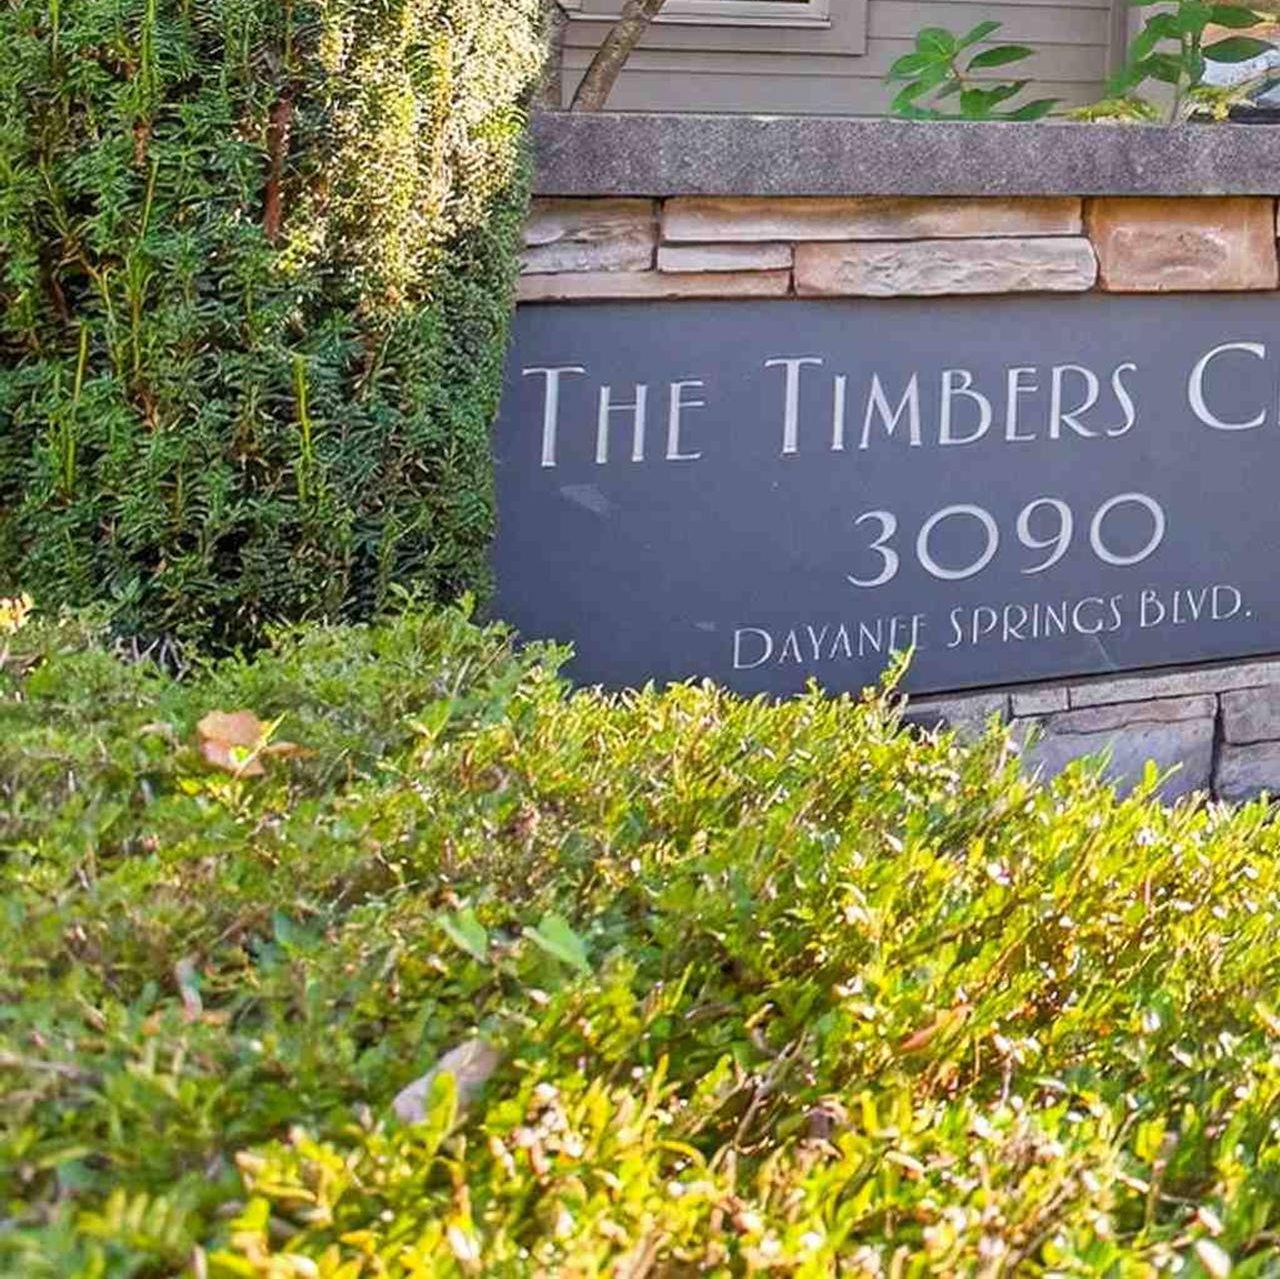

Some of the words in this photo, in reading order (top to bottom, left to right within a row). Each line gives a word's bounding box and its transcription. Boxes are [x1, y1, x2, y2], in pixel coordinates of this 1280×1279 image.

[522, 366, 705, 467] THE
[764, 357, 1137, 454] TIMBERS
[847, 492, 1165, 587] 3090
[947, 594, 1122, 648] SPRINGS
[1140, 584, 1251, 627] BLVD.
